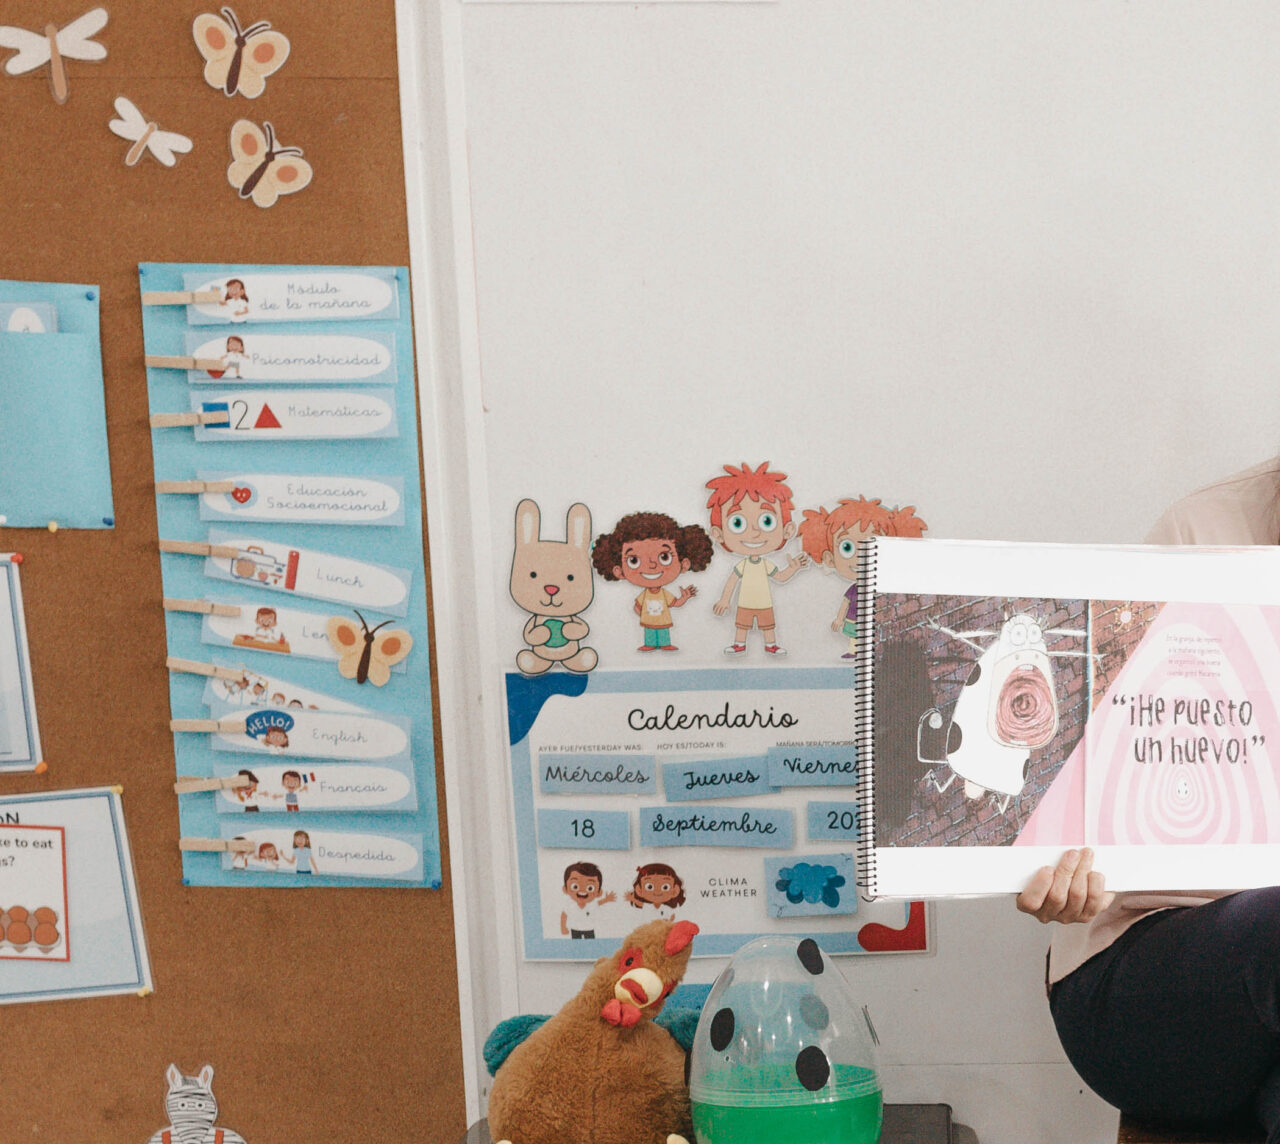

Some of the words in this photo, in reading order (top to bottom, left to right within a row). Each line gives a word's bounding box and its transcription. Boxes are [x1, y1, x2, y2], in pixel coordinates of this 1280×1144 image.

[259, 299, 280, 310] de
[286, 298, 302, 310] la
[308, 299, 371, 310] mañana
[252, 353, 381, 366] Psicomotricidad
[232, 400, 250, 430] 2
[288, 405, 382, 417] Matemáticas
[287, 483, 368, 497] Educación
[266, 496, 389, 512] Socioemocional
[316, 567, 364, 588] Lunch
[248, 715, 291, 735] HELLO!
[627, 702, 799, 732] Calendario
[312, 728, 369, 746] English
[1134, 736, 1163, 764] un
[545, 764, 650, 784] Miércoles
[783, 758, 860, 774] Vierne
[683, 770, 760, 790] Jueves
[320, 781, 388, 796] Français
[571, 820, 596, 838] 18
[652, 813, 778, 839] Septiembre
[15, 838, 28, 848] to
[32, 839, 54, 849] eat
[318, 846, 396, 862] Despedida
[709, 878, 748, 887] CLIMA
[700, 889, 758, 898] WEATHER
